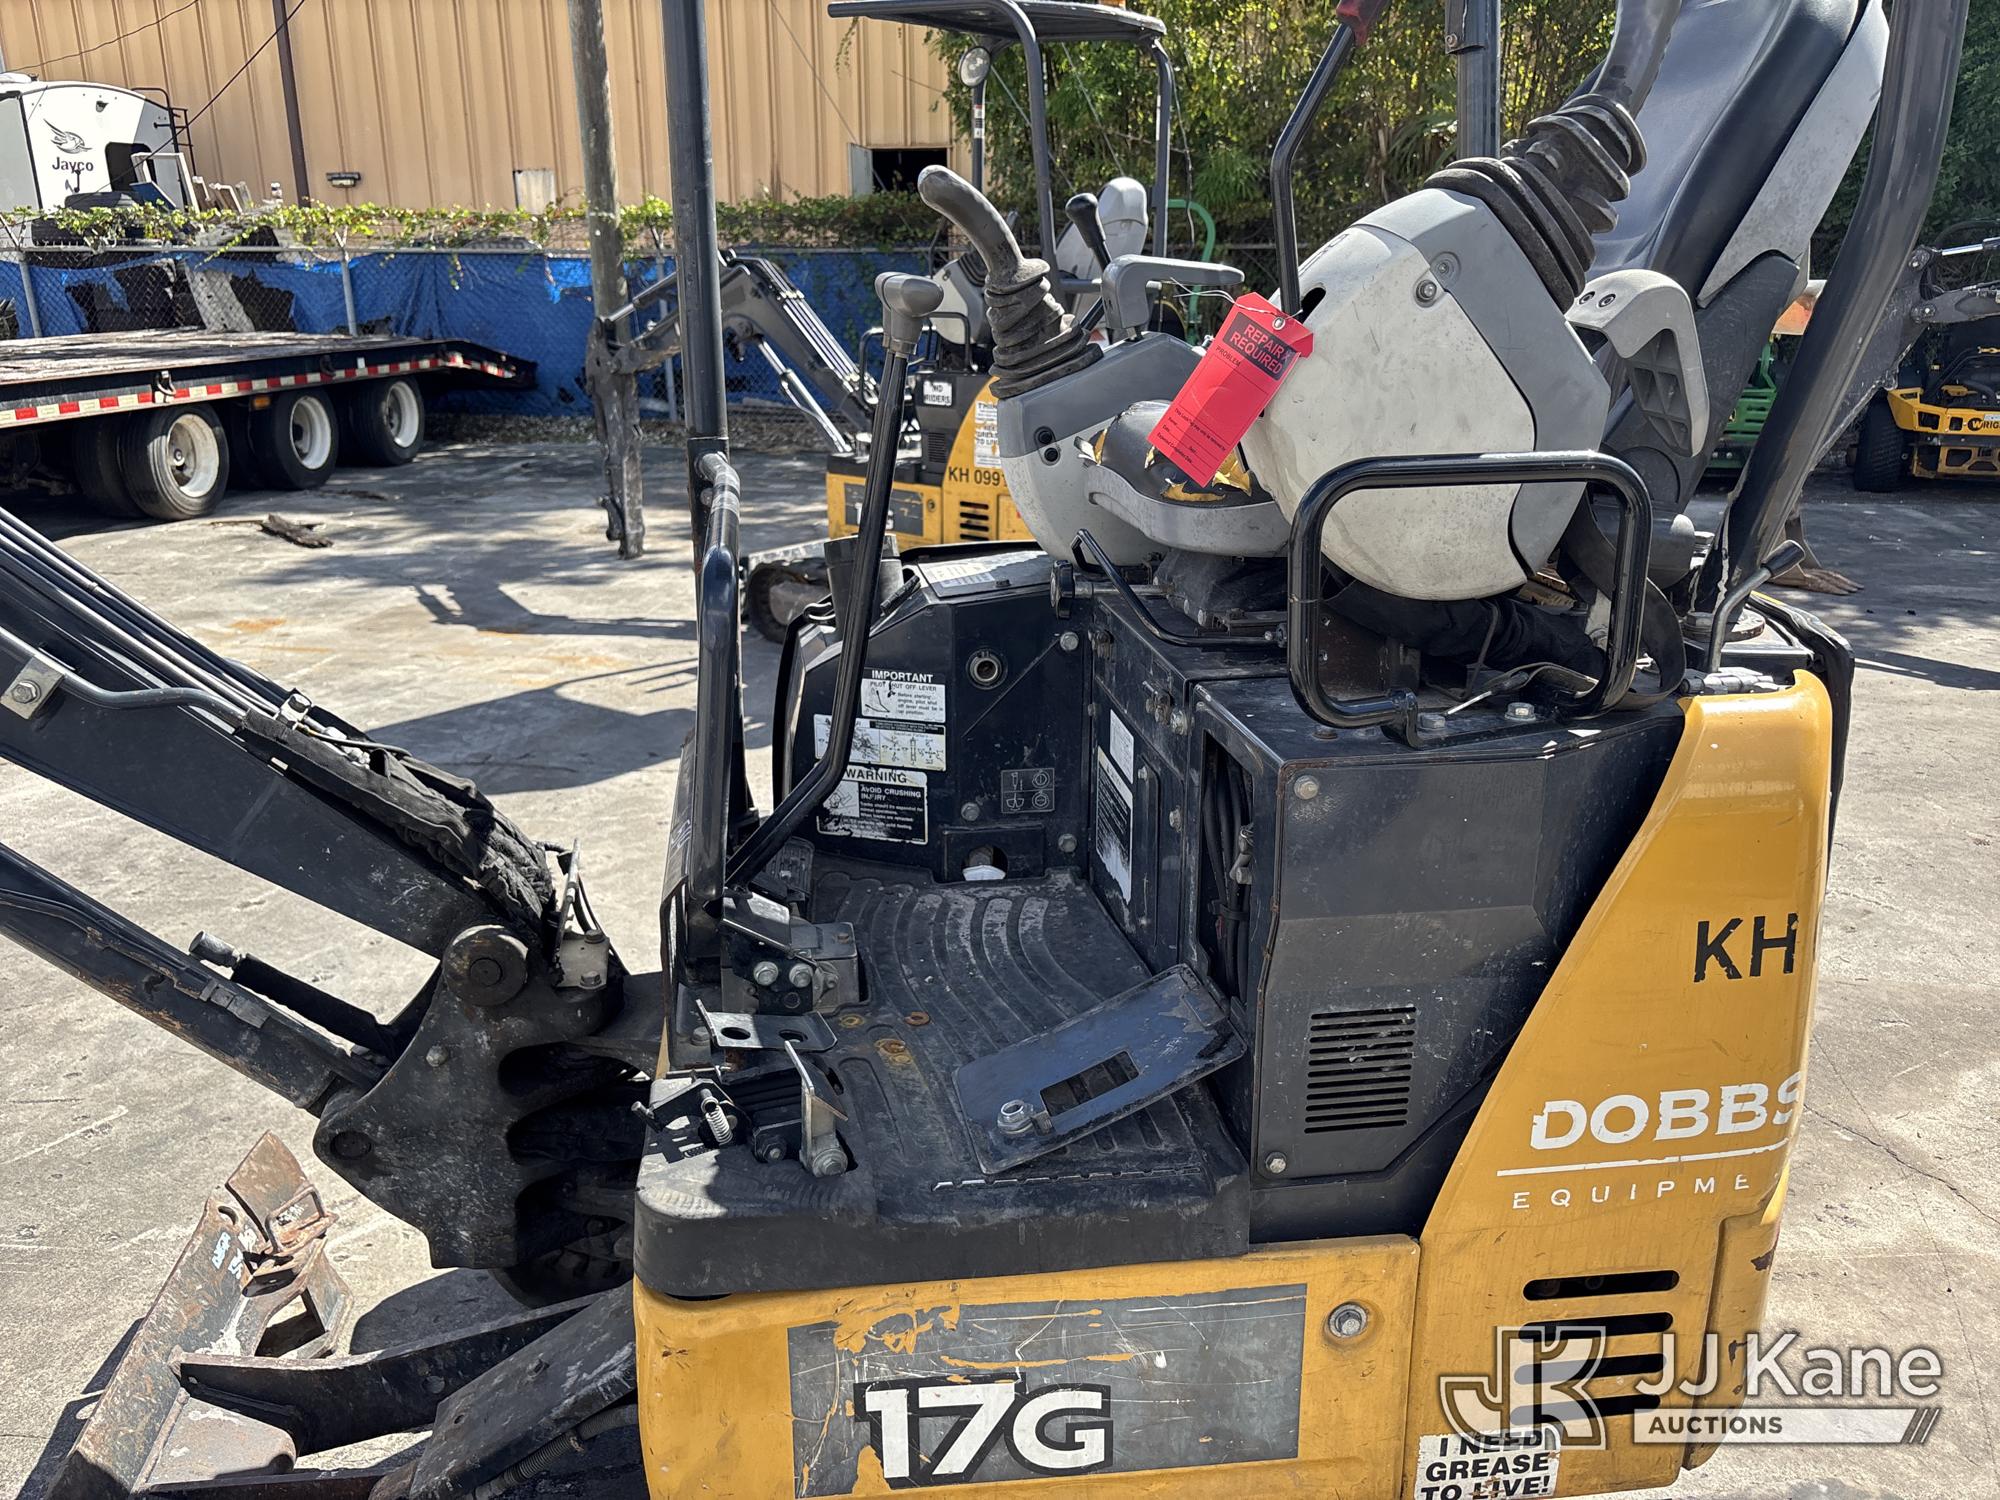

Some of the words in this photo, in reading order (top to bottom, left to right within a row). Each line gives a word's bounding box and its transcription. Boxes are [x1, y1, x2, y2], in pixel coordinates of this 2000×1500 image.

[52, 156, 94, 174] Jayco
[1230, 331, 1283, 374] REQUIRED
[1244, 324, 1285, 359] REPAIR
[1215, 346, 1242, 366] PROBLEM
[948, 466, 970, 483] KH
[871, 669, 934, 684] IMPORTANT
[845, 768, 907, 784] WARNING
[861, 786, 882, 794] AVOID
[884, 788, 922, 798] CRUSHING
[1694, 912, 1799, 983] KH
[861, 1378, 1109, 1482] 17G
[1439, 1438, 1449, 1457] I
[1459, 1430, 1543, 1456] NEED
[1425, 1452, 1551, 1482] GREASE
[1420, 1485, 1462, 1500] TO
[1472, 1475, 1550, 1500] LIVE!
